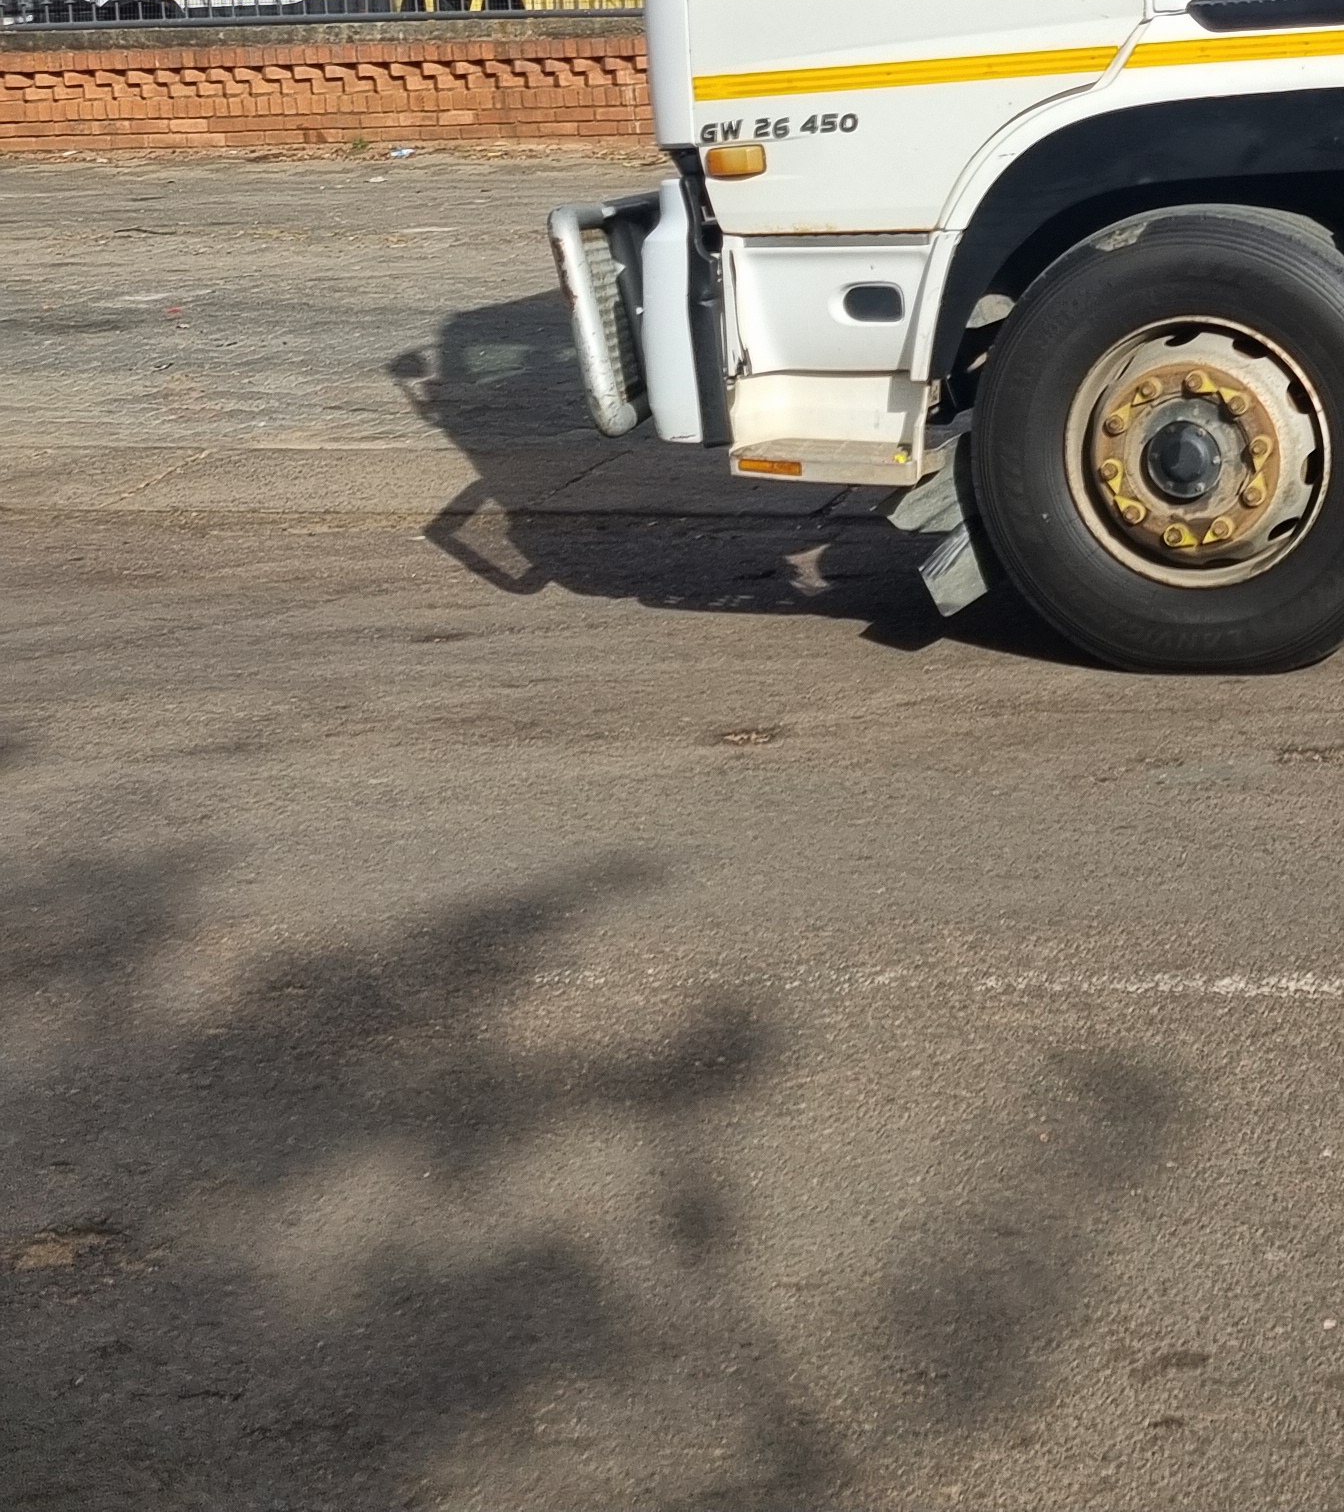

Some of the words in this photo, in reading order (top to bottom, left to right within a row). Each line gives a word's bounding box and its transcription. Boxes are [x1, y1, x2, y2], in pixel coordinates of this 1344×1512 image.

[700, 119, 743, 143] GW
[753, 117, 790, 138] 26
[800, 113, 859, 134] 450
